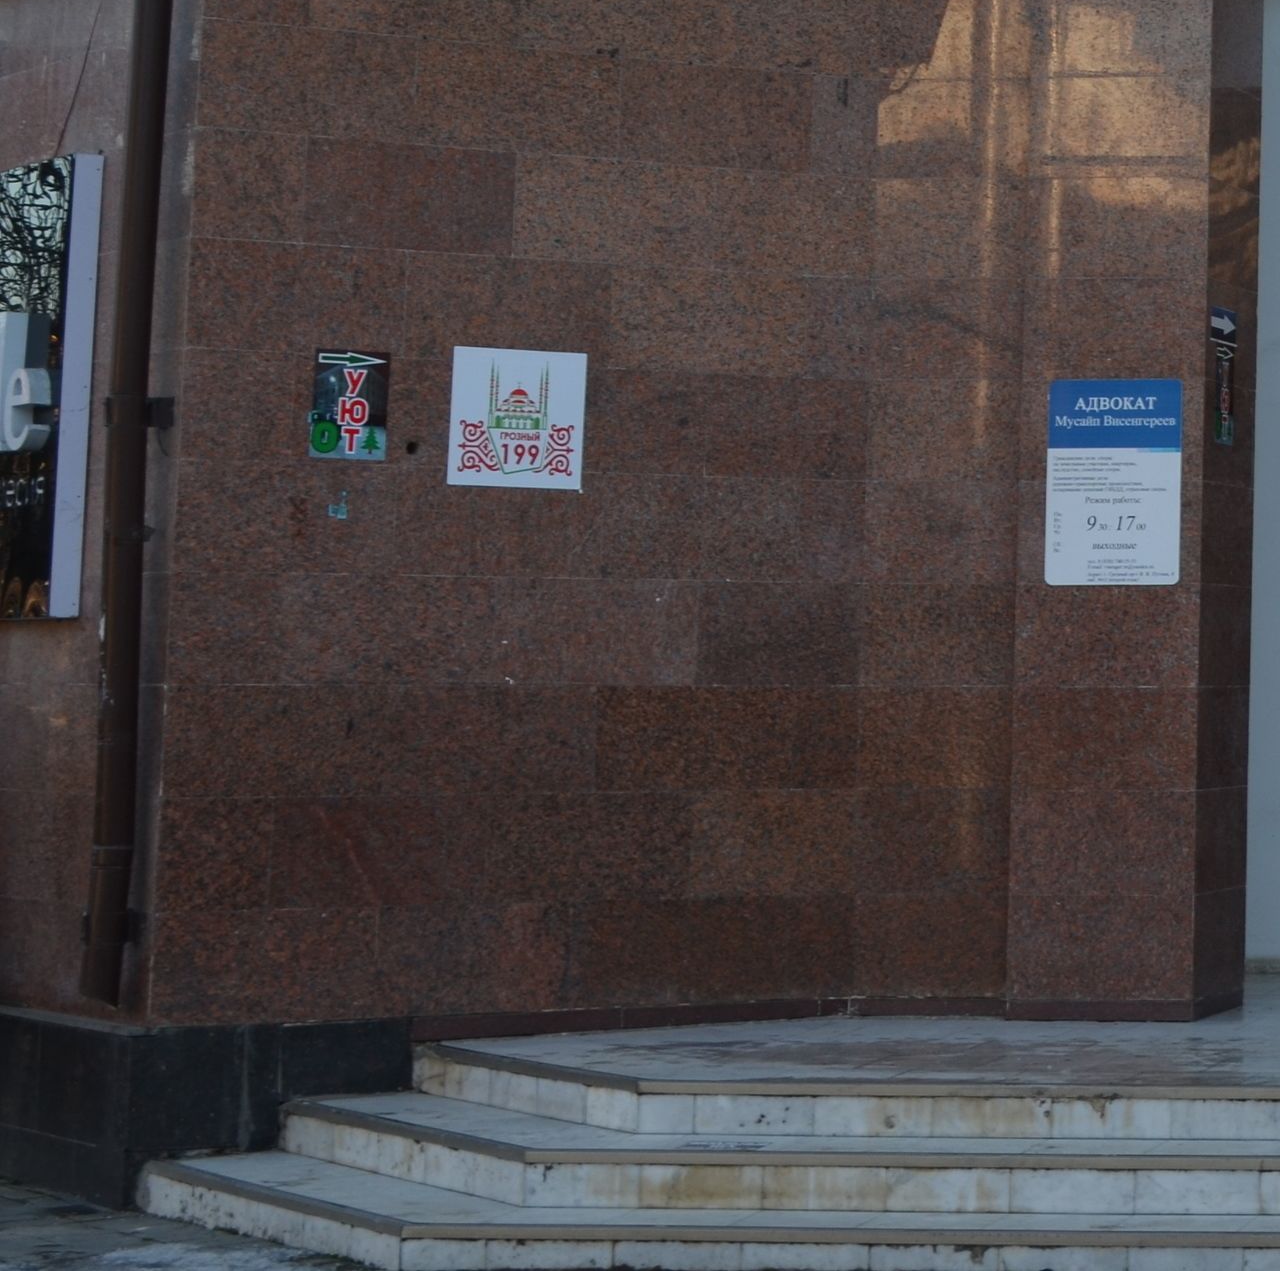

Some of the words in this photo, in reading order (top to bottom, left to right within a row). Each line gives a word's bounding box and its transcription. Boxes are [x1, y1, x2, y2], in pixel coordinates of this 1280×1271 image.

[337, 369, 369, 454] УЮТ
[1074, 396, 1157, 413] АДВОКАТ
[499, 431, 541, 441] ГРОЗНЫЙ
[501, 443, 540, 466] 199
[1086, 515, 1097, 532] 9
[1116, 515, 1136, 531] 17
